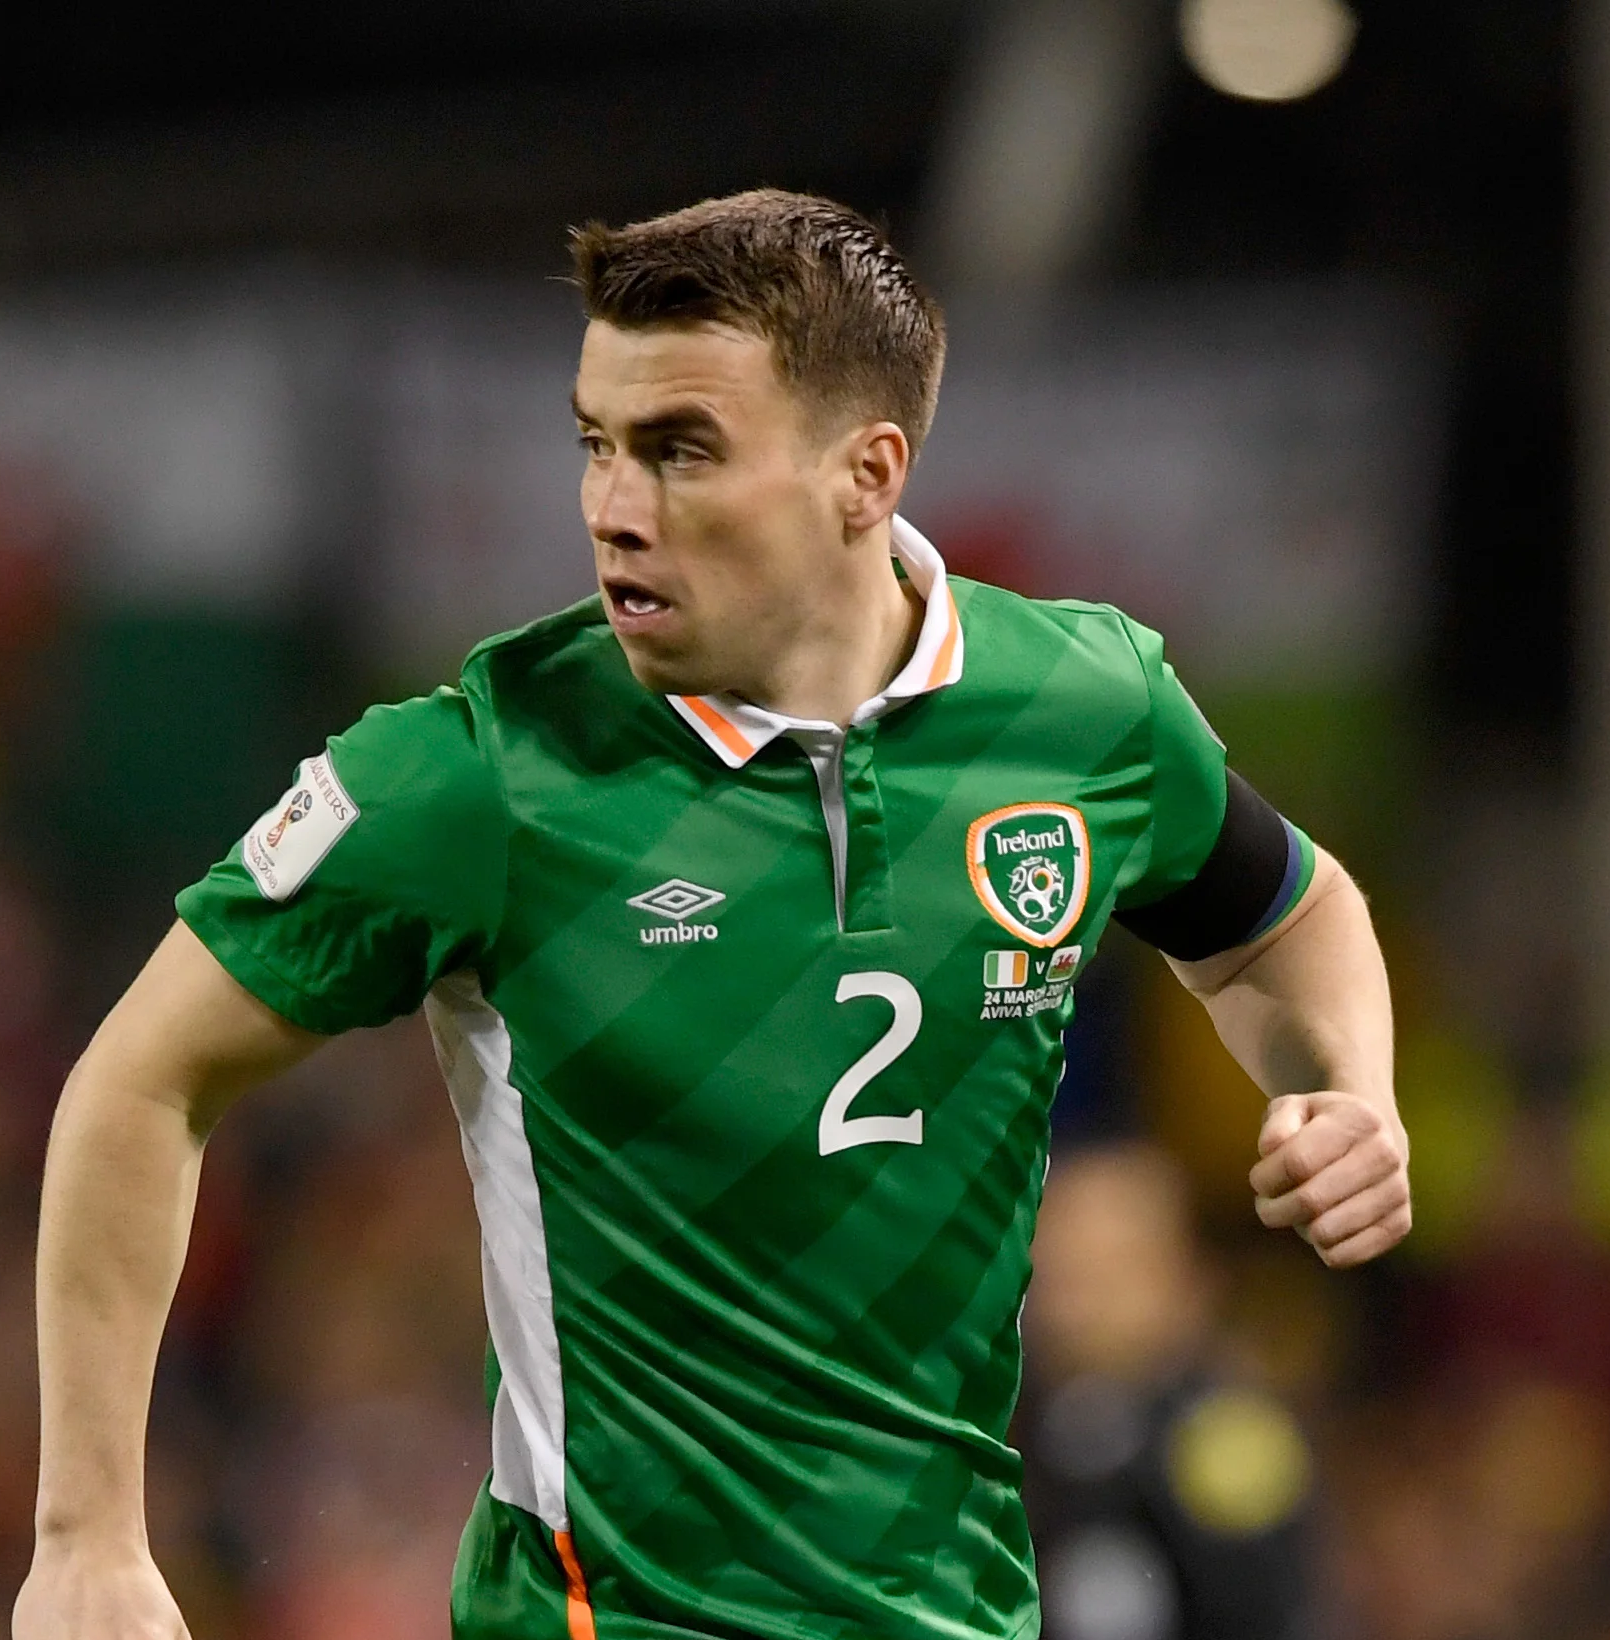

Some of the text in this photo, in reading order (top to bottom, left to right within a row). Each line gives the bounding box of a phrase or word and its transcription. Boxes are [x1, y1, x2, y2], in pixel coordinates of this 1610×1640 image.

[308, 758, 349, 821] UALIFIERS
[992, 824, 1065, 855] Ireland
[640, 921, 719, 944] umbro
[984, 991, 1000, 1005] 24
[980, 1005, 1023, 1020] AVIVA
[818, 971, 923, 1157] 2
